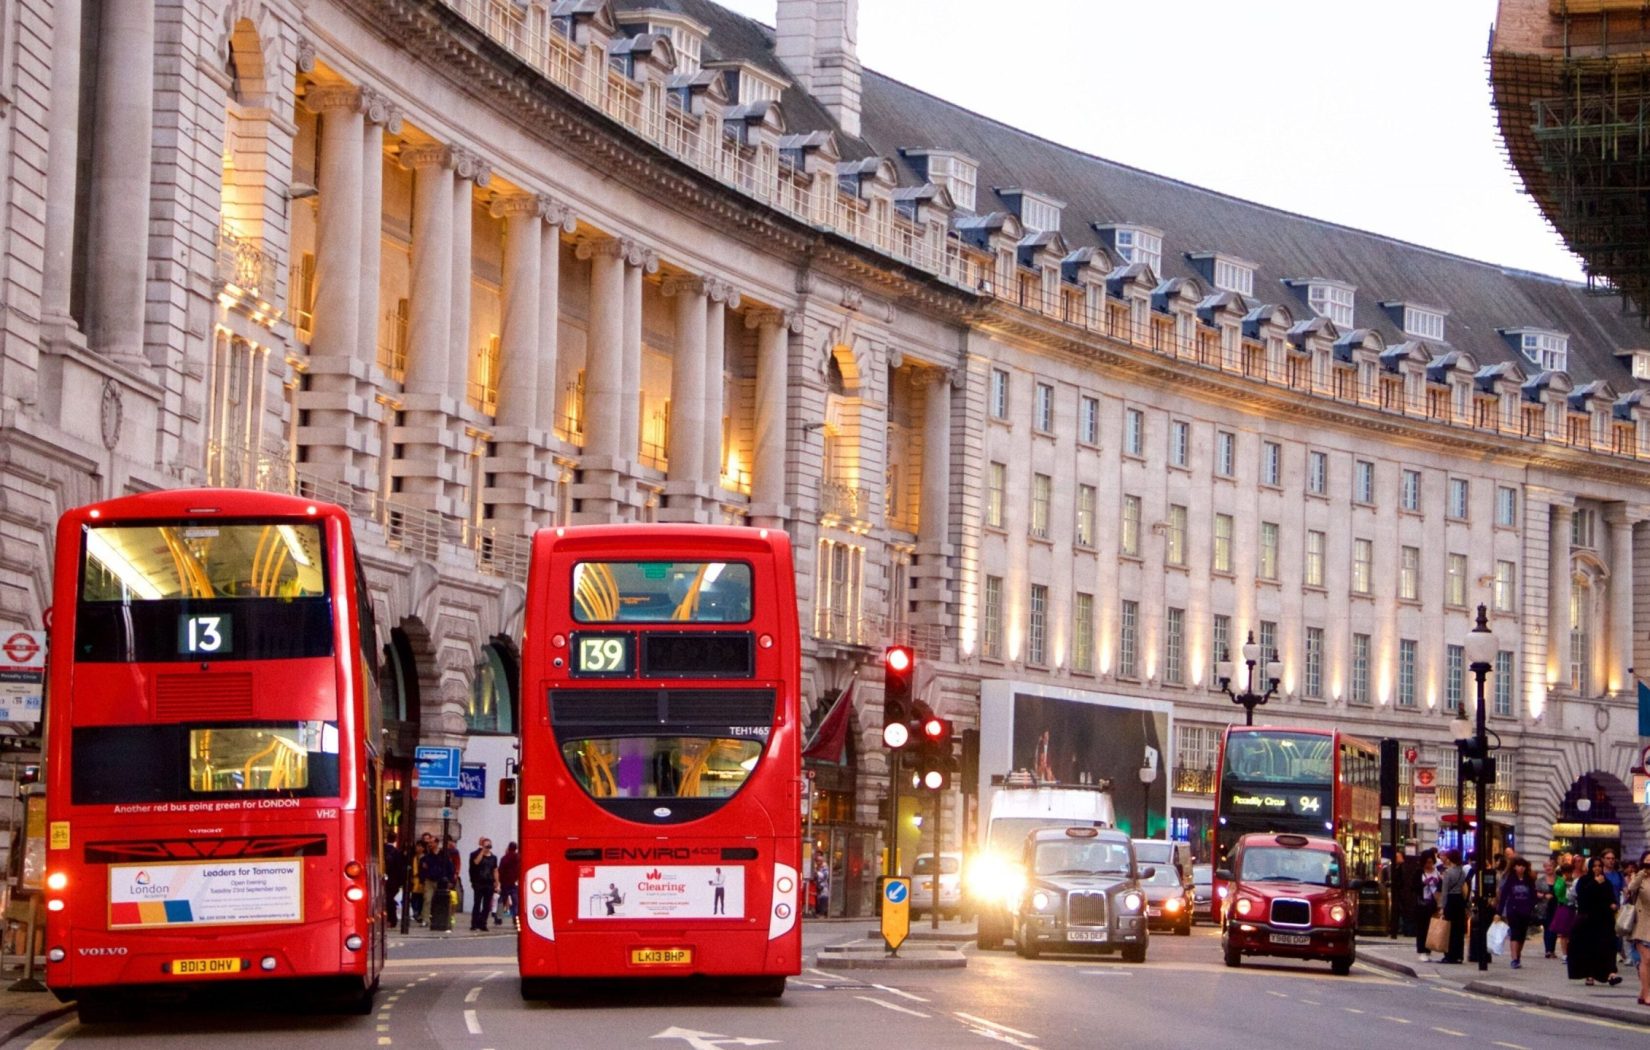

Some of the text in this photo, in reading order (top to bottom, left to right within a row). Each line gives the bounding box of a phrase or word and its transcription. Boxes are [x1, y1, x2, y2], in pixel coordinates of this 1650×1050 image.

[189, 617, 222, 652] 13
[580, 640, 623, 670] 139
[729, 726, 770, 736] TEH1465
[114, 799, 300, 814] Another red bus going green for LONDON
[1300, 796, 1320, 812] 94
[316, 809, 337, 819] VH2
[604, 848, 690, 860] ENVIRO
[203, 867, 294, 878] Leaders for Tomorrow
[130, 884, 170, 895] London
[246, 886, 273, 894] September
[638, 881, 686, 893] Clearing
[79, 947, 129, 956] VOLVO
[638, 951, 684, 962] LK13 BHP
[180, 959, 233, 973] BD13 OHV
